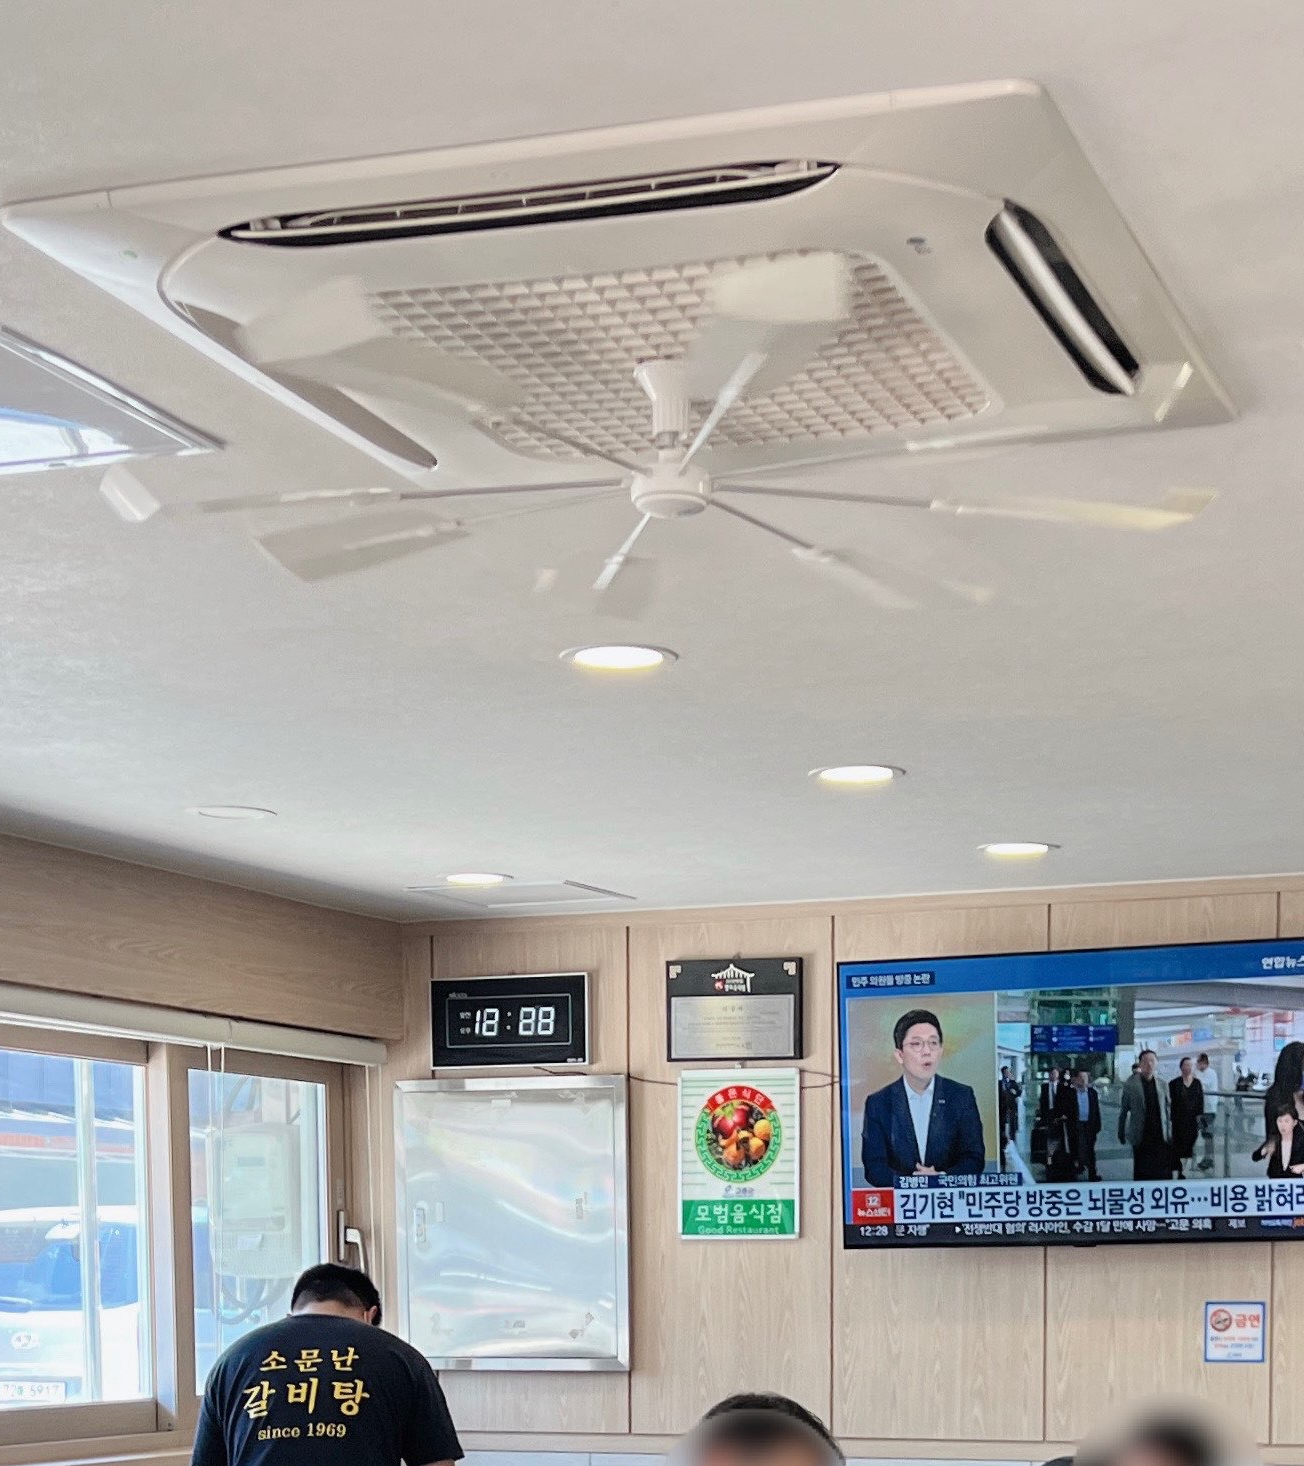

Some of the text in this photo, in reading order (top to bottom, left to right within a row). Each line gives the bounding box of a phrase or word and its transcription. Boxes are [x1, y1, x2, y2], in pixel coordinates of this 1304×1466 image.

[695, 1203, 782, 1225] 모범음식점
[900, 1193, 954, 1219] 김기현
[959, 1190, 1021, 1218] "민주당
[1027, 1189, 1082, 1216] 방중은
[1088, 1188, 1145, 1215] 뇌물성
[259, 1347, 359, 1372] 소문난
[243, 1377, 370, 1419] 갈비탕
[258, 1423, 346, 1440] since 1969
